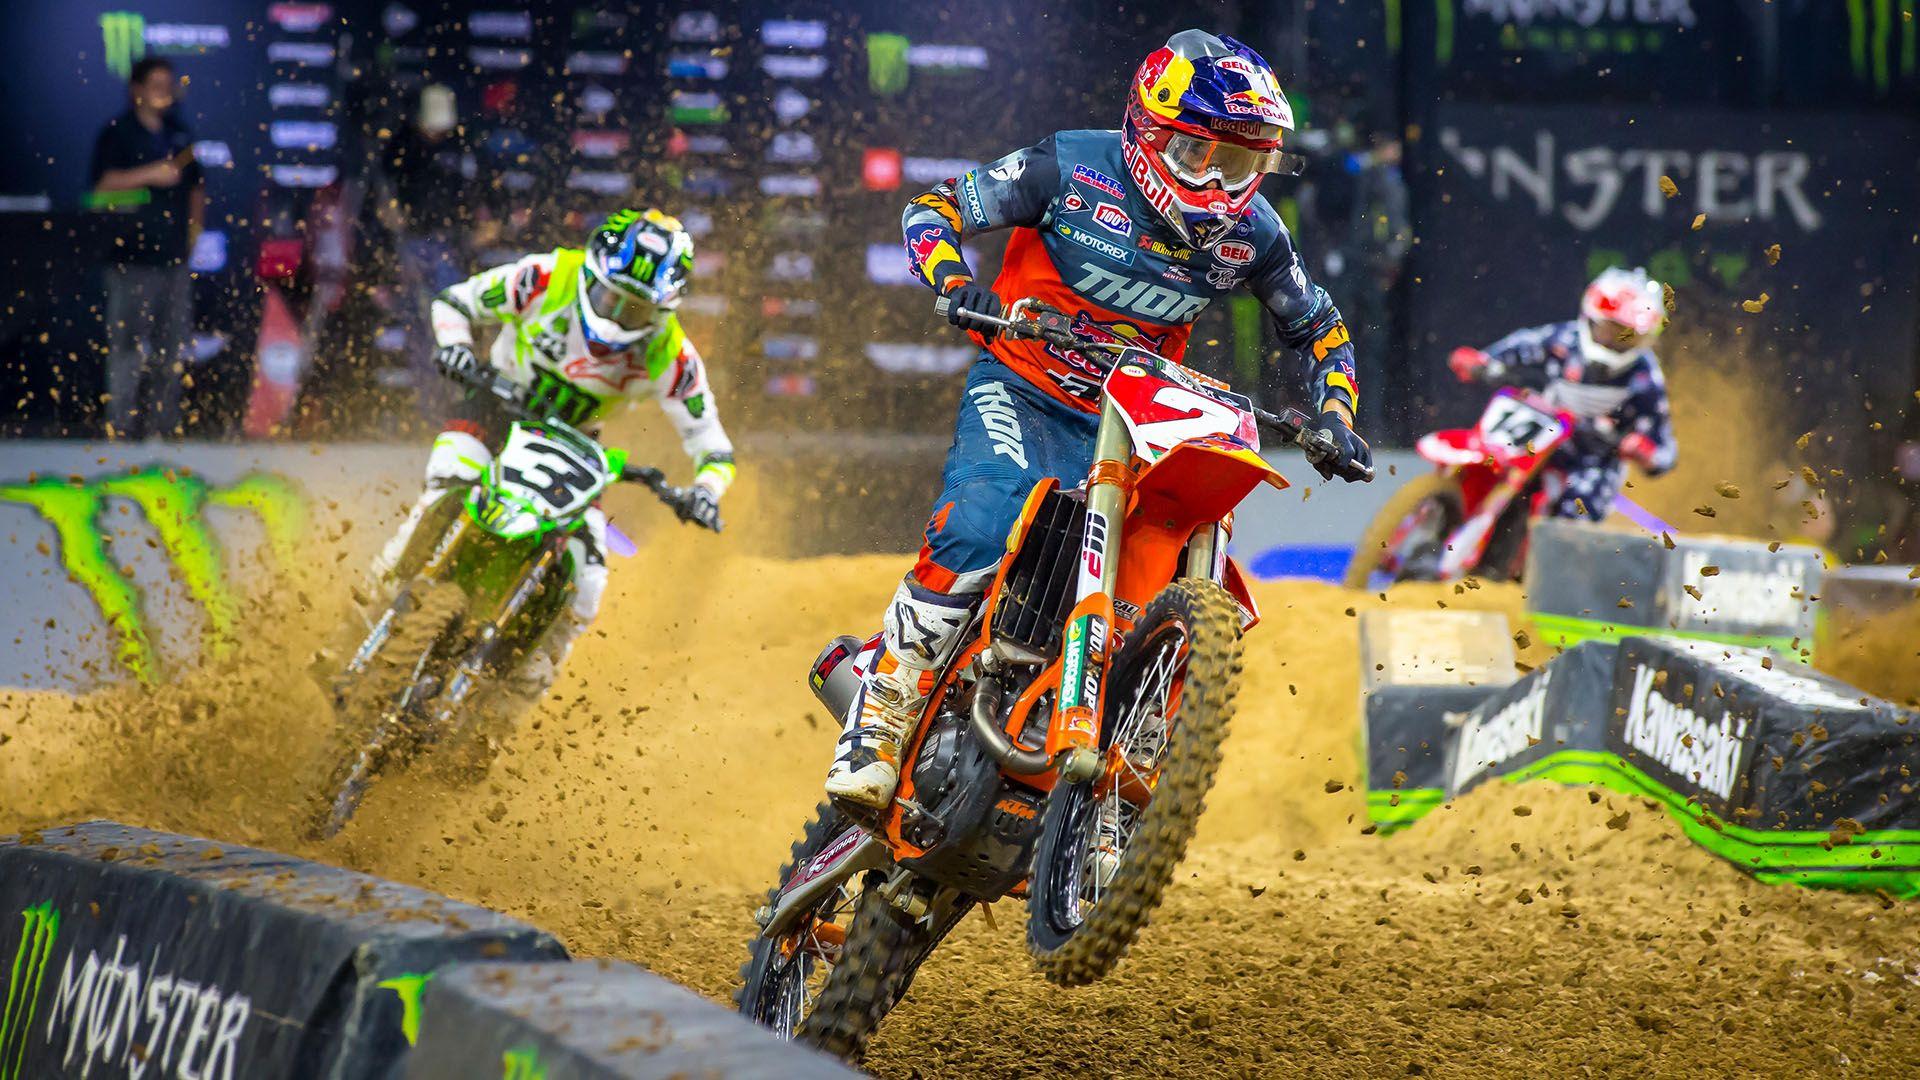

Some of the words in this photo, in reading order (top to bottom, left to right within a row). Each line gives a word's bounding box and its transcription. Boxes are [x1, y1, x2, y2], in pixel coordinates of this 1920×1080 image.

[1221, 61, 1252, 74] BELL
[1211, 118, 1237, 131] Red
[1239, 121, 1261, 137] Bull
[1227, 104, 1261, 115] Red
[1261, 108, 1289, 122] Bull
[1074, 164, 1126, 194] PARTS
[1131, 158, 1174, 215] Bull
[1439, 128, 1823, 232] NSTER
[1072, 230, 1130, 262] MOTOREX
[1100, 207, 1130, 233] 100%
[1219, 244, 1250, 261] BELL
[1073, 262, 1211, 323] THOR
[968, 381, 1029, 470] THOR
[1137, 385, 1240, 451] 2
[502, 441, 598, 509] 3
[1083, 617, 1104, 707] DUOP
[1623, 663, 1748, 800] Kawasaki
[995, 800, 1038, 820] KTM
[46, 933, 251, 1080] MONSTER
